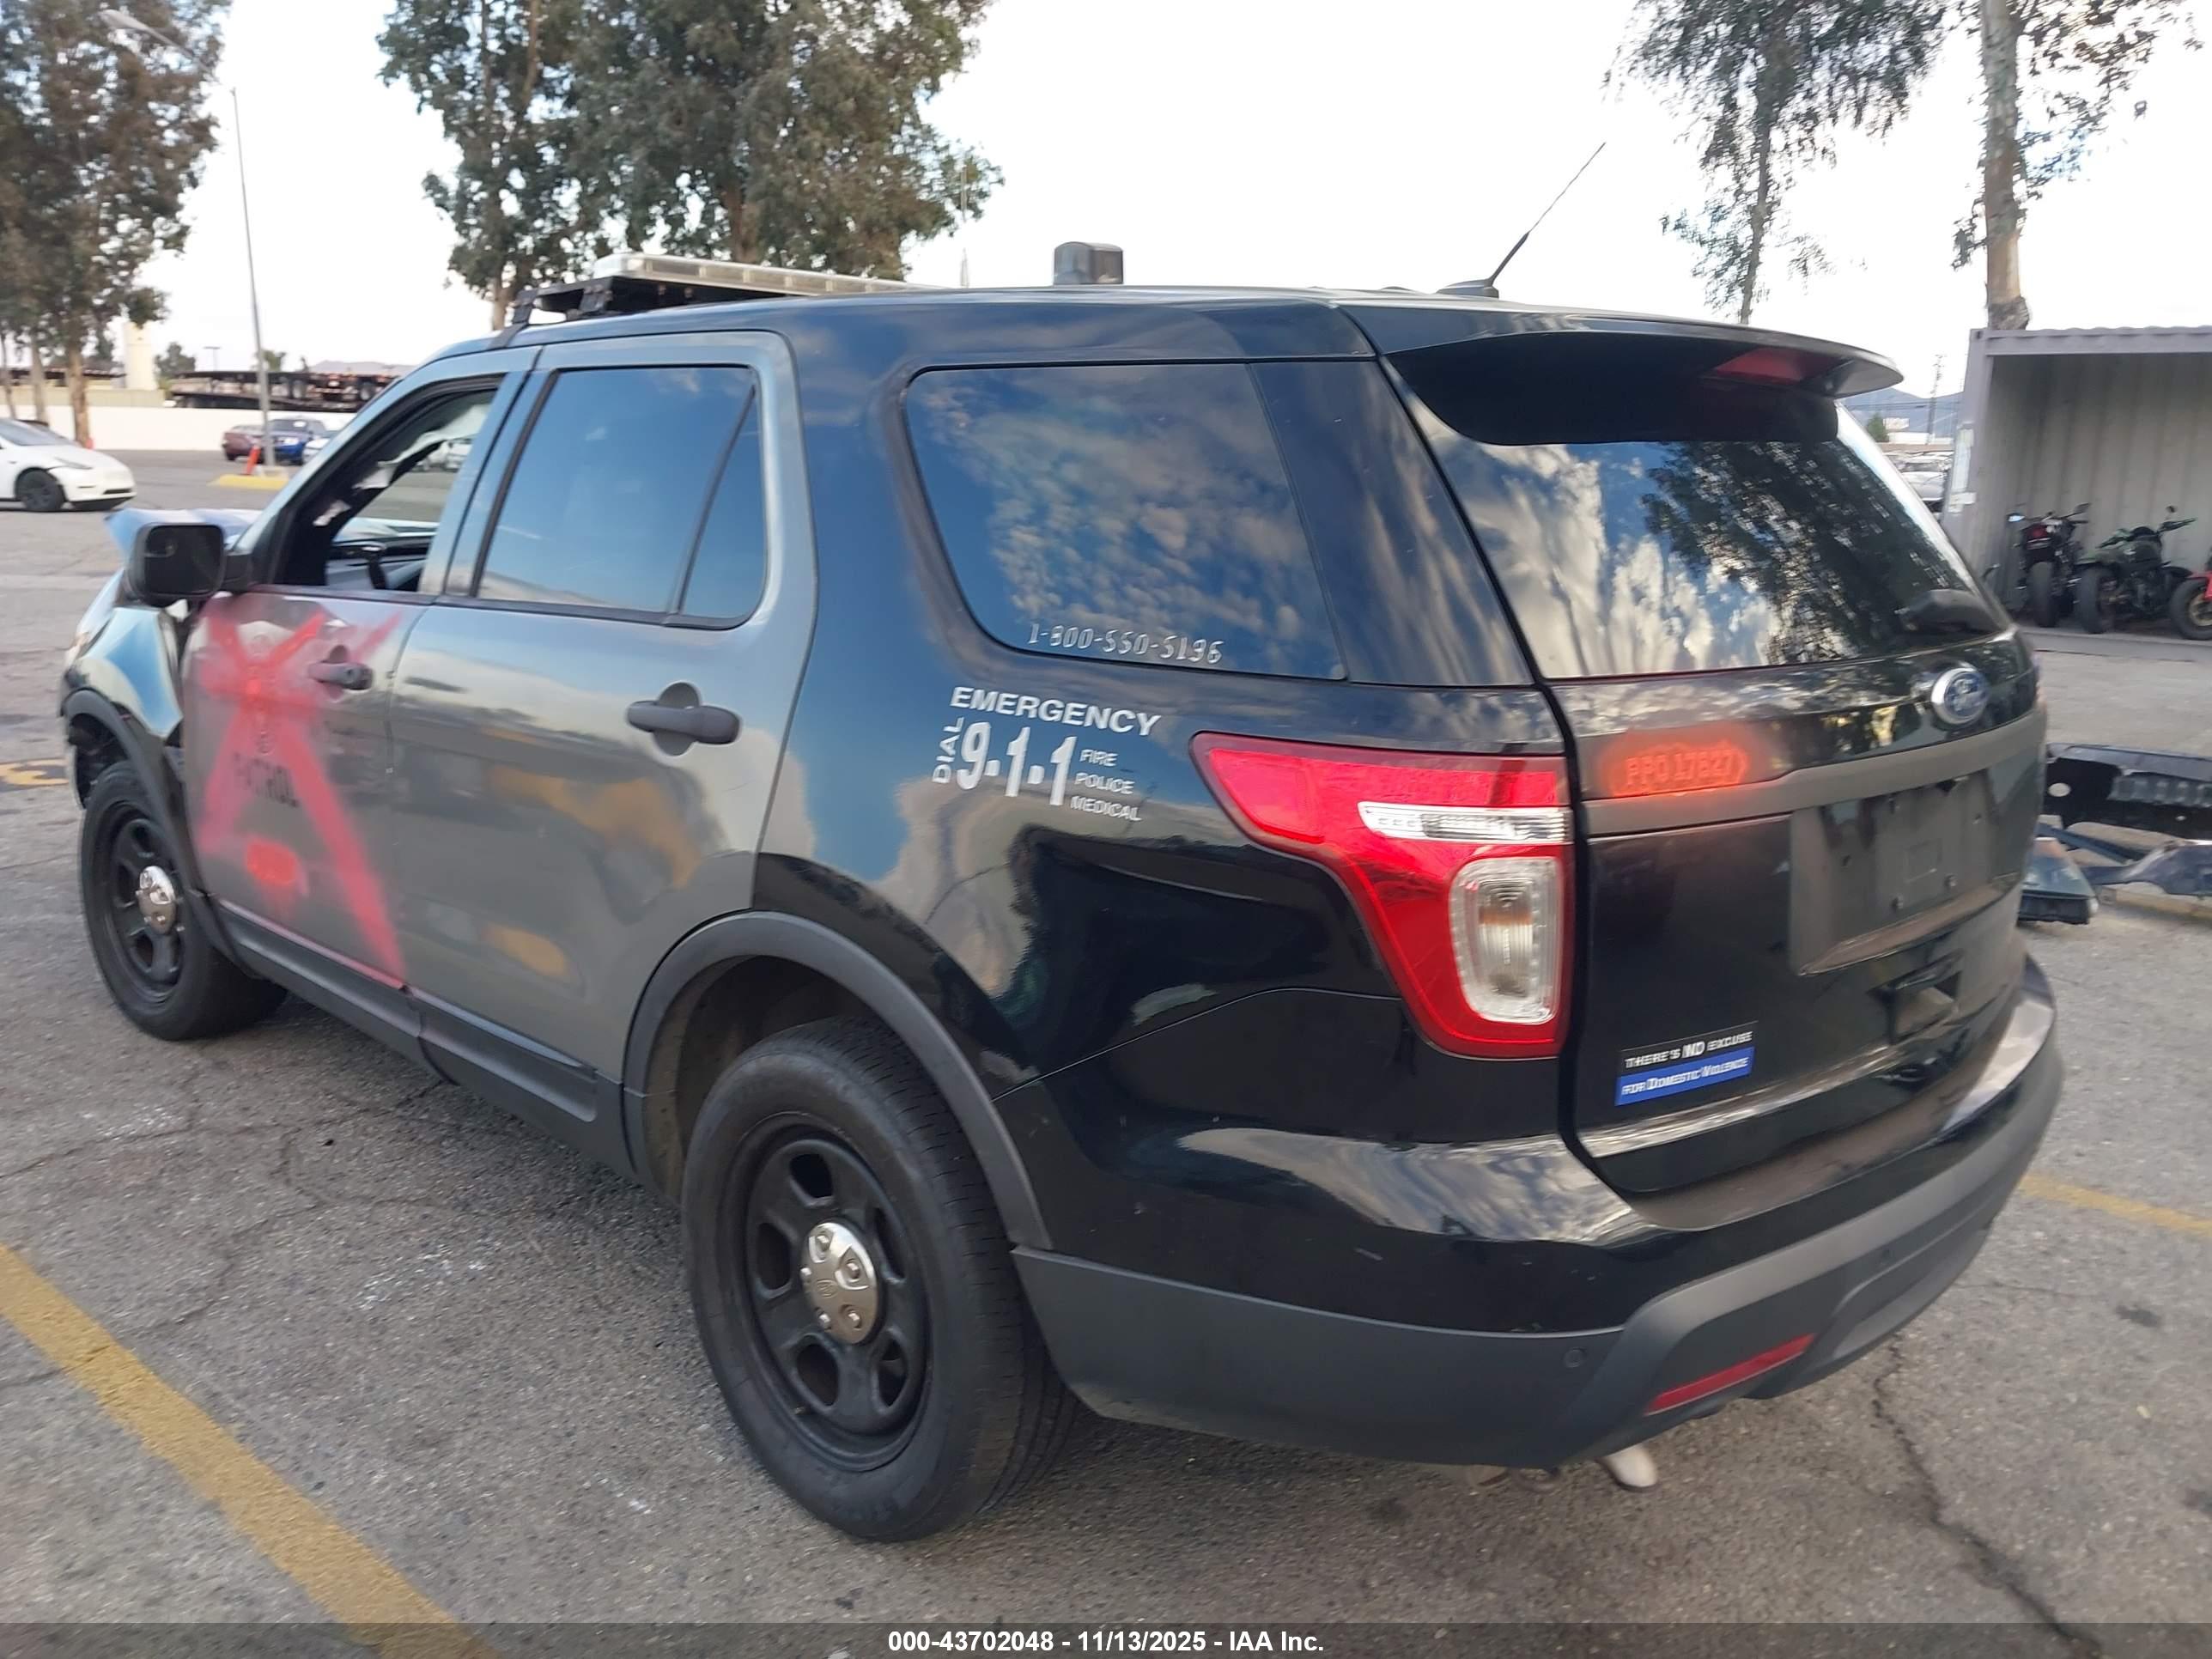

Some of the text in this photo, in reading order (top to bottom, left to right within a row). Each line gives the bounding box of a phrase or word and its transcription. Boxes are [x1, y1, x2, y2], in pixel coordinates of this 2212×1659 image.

[950, 686, 1161, 736] EMERGENCY
[932, 716, 964, 783] DIAL
[1080, 749, 1118, 767] FIRE
[1074, 772, 1135, 795] POLICE
[1070, 795, 1143, 822] MEDICAL
[1625, 1030, 1753, 1069] THERE'S NO EXCUSE
